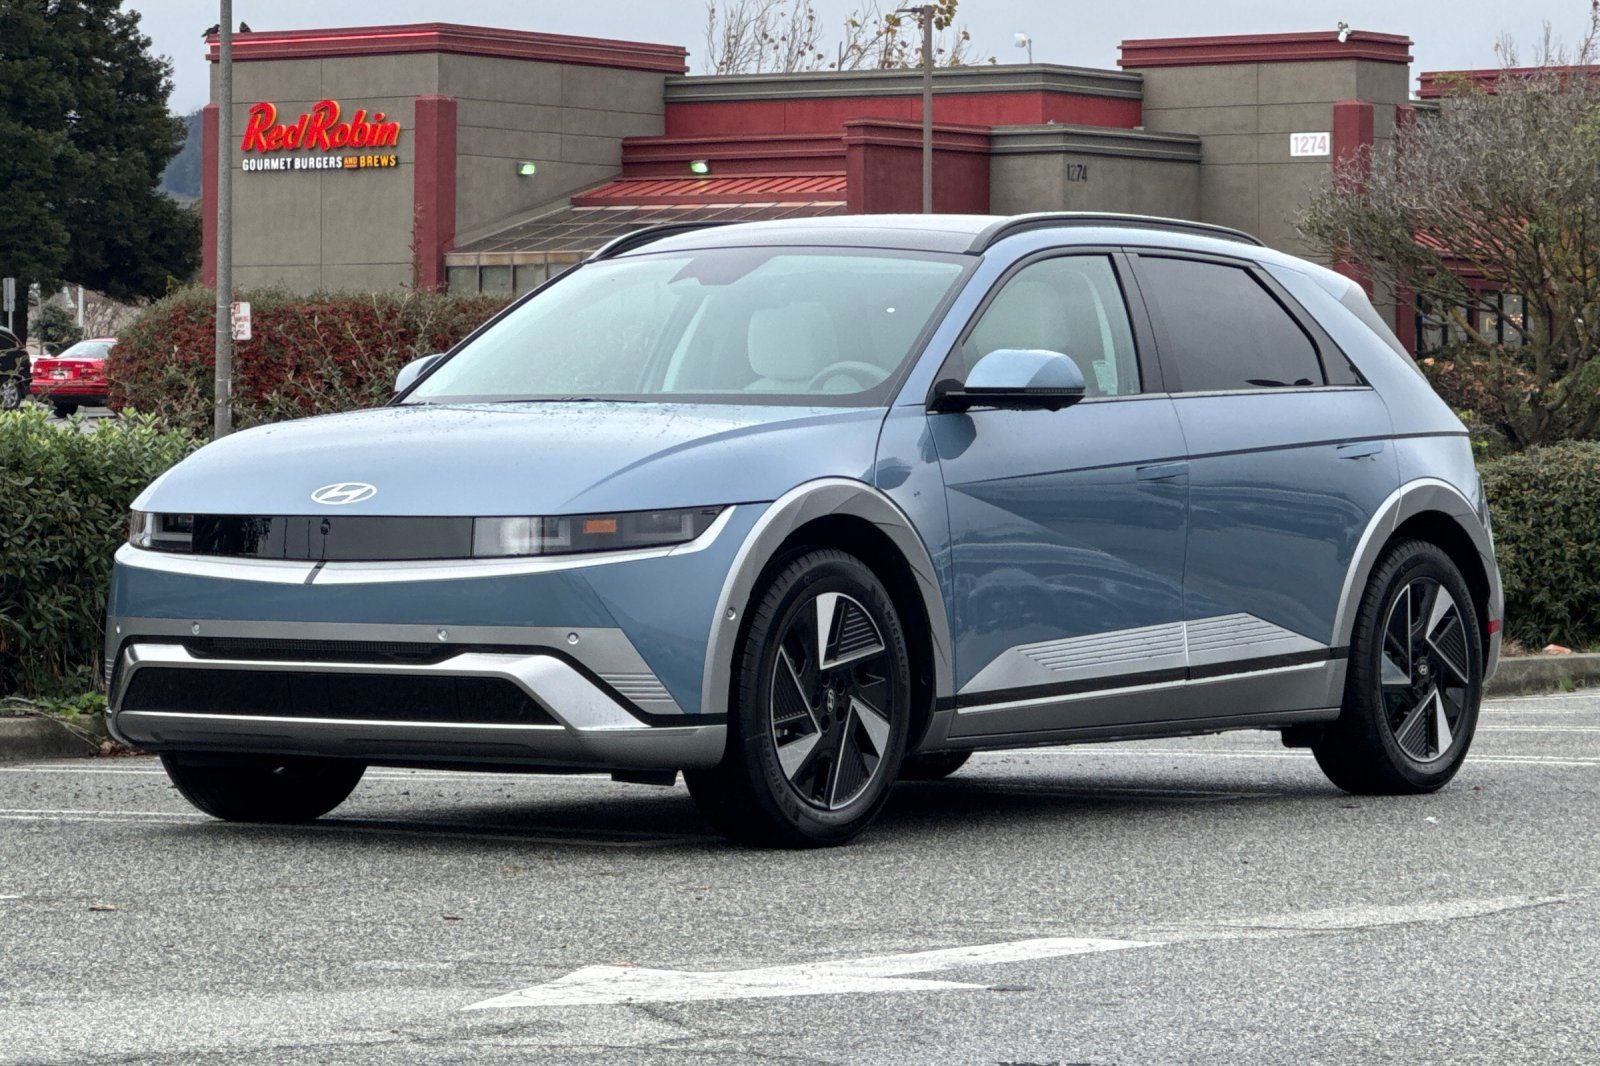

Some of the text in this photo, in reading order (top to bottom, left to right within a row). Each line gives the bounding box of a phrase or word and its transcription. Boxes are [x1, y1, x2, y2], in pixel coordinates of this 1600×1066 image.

[241, 100, 400, 152] Red Robin
[1293, 135, 1328, 153] 1274
[242, 157, 293, 171] GOURMET
[294, 156, 342, 170] BURGERS
[359, 154, 396, 168] BREWS
[1066, 163, 1088, 183] 1274
